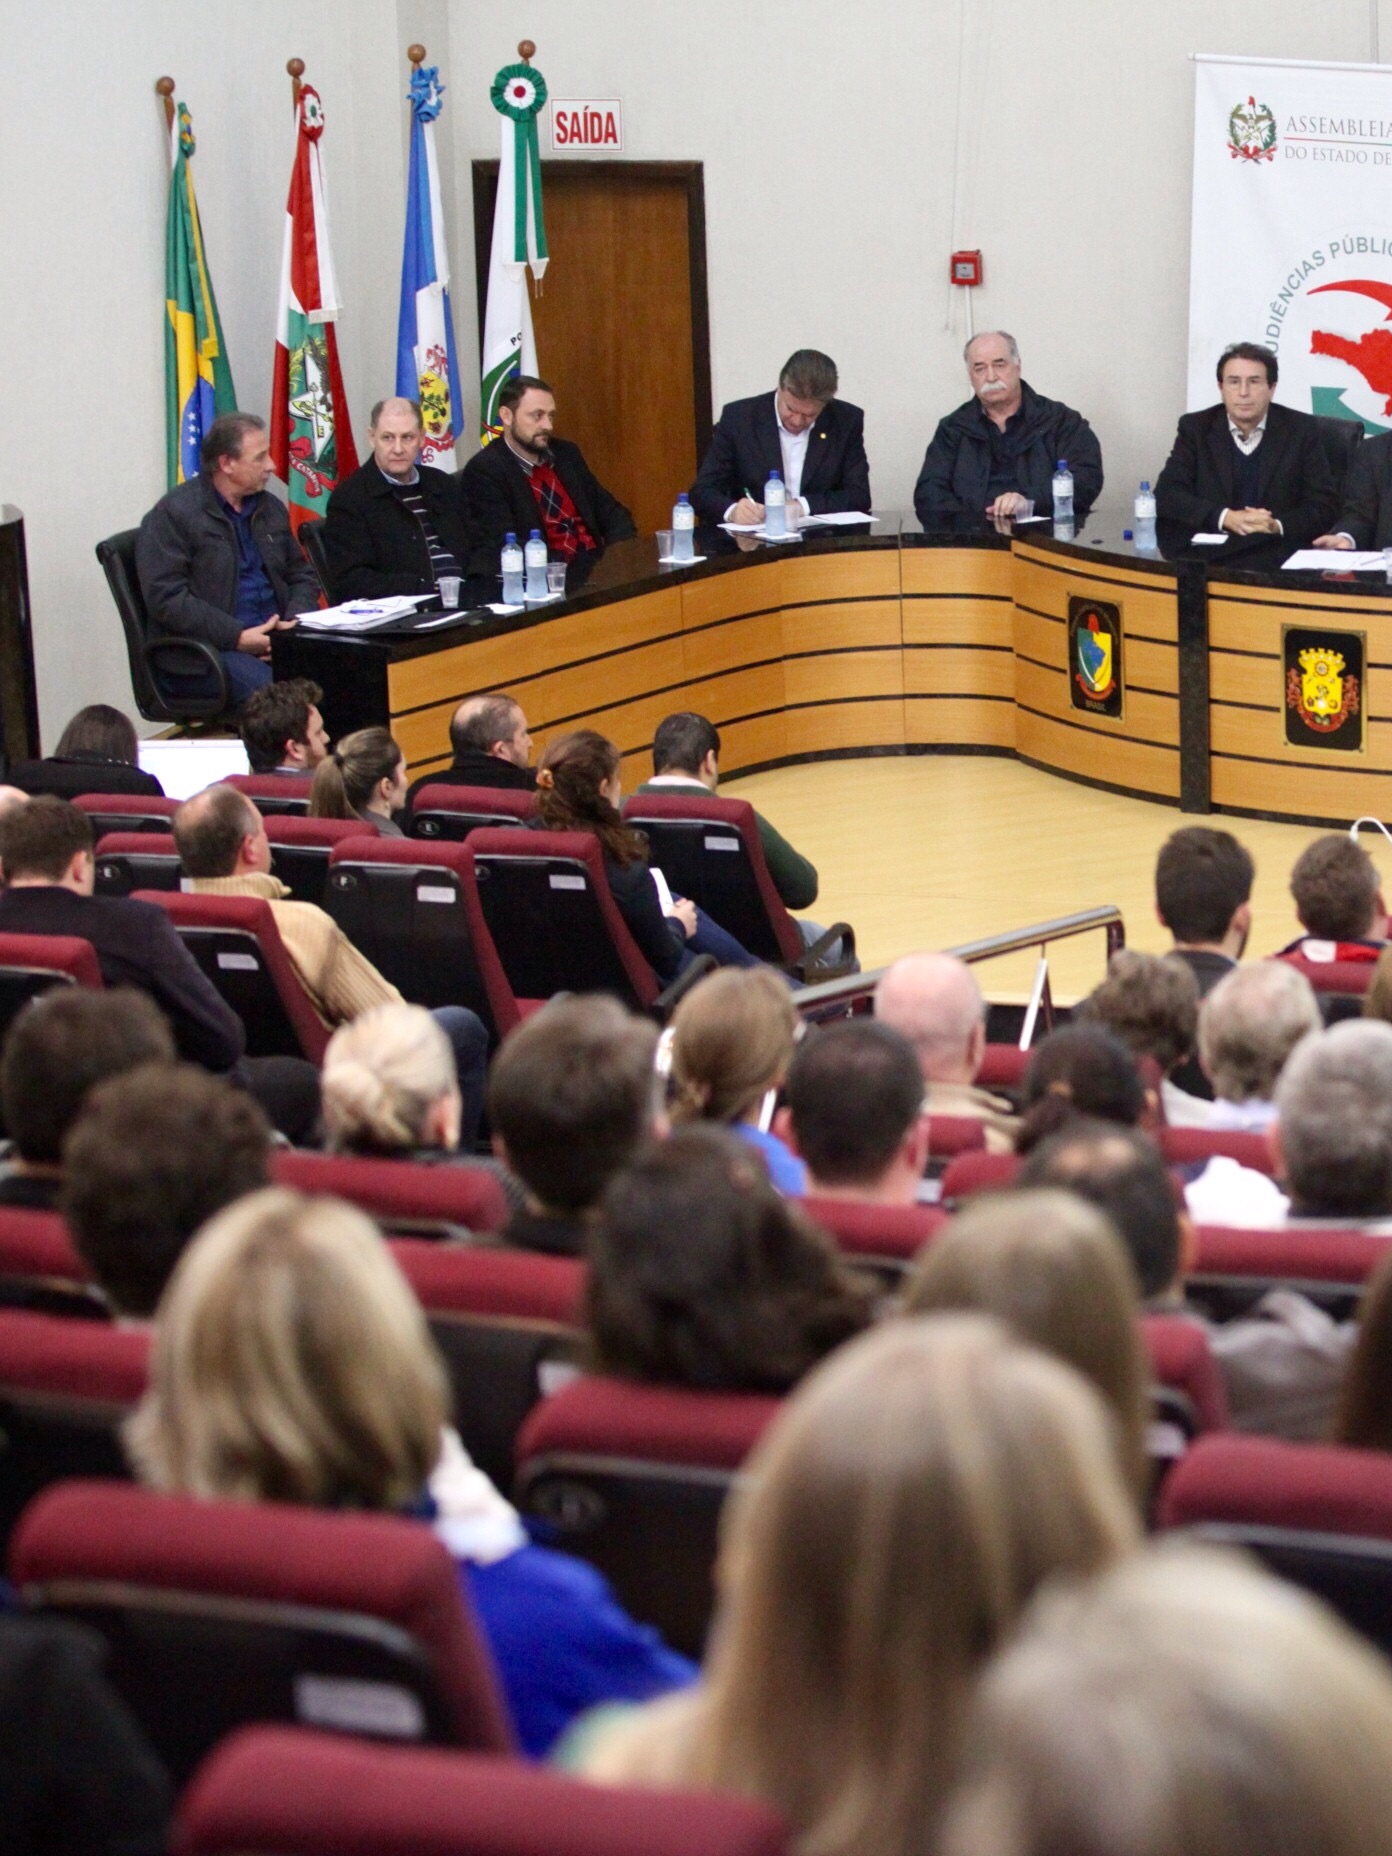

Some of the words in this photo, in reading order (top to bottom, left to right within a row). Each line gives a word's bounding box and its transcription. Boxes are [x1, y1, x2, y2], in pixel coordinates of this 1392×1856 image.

[555, 105, 618, 144] SAÍDA
[1284, 145, 1307, 160] DO
[1312, 147, 1368, 165] ESTADO
[1373, 151, 1392, 166] DE
[1265, 250, 1326, 355] UDIÊNCIAS
